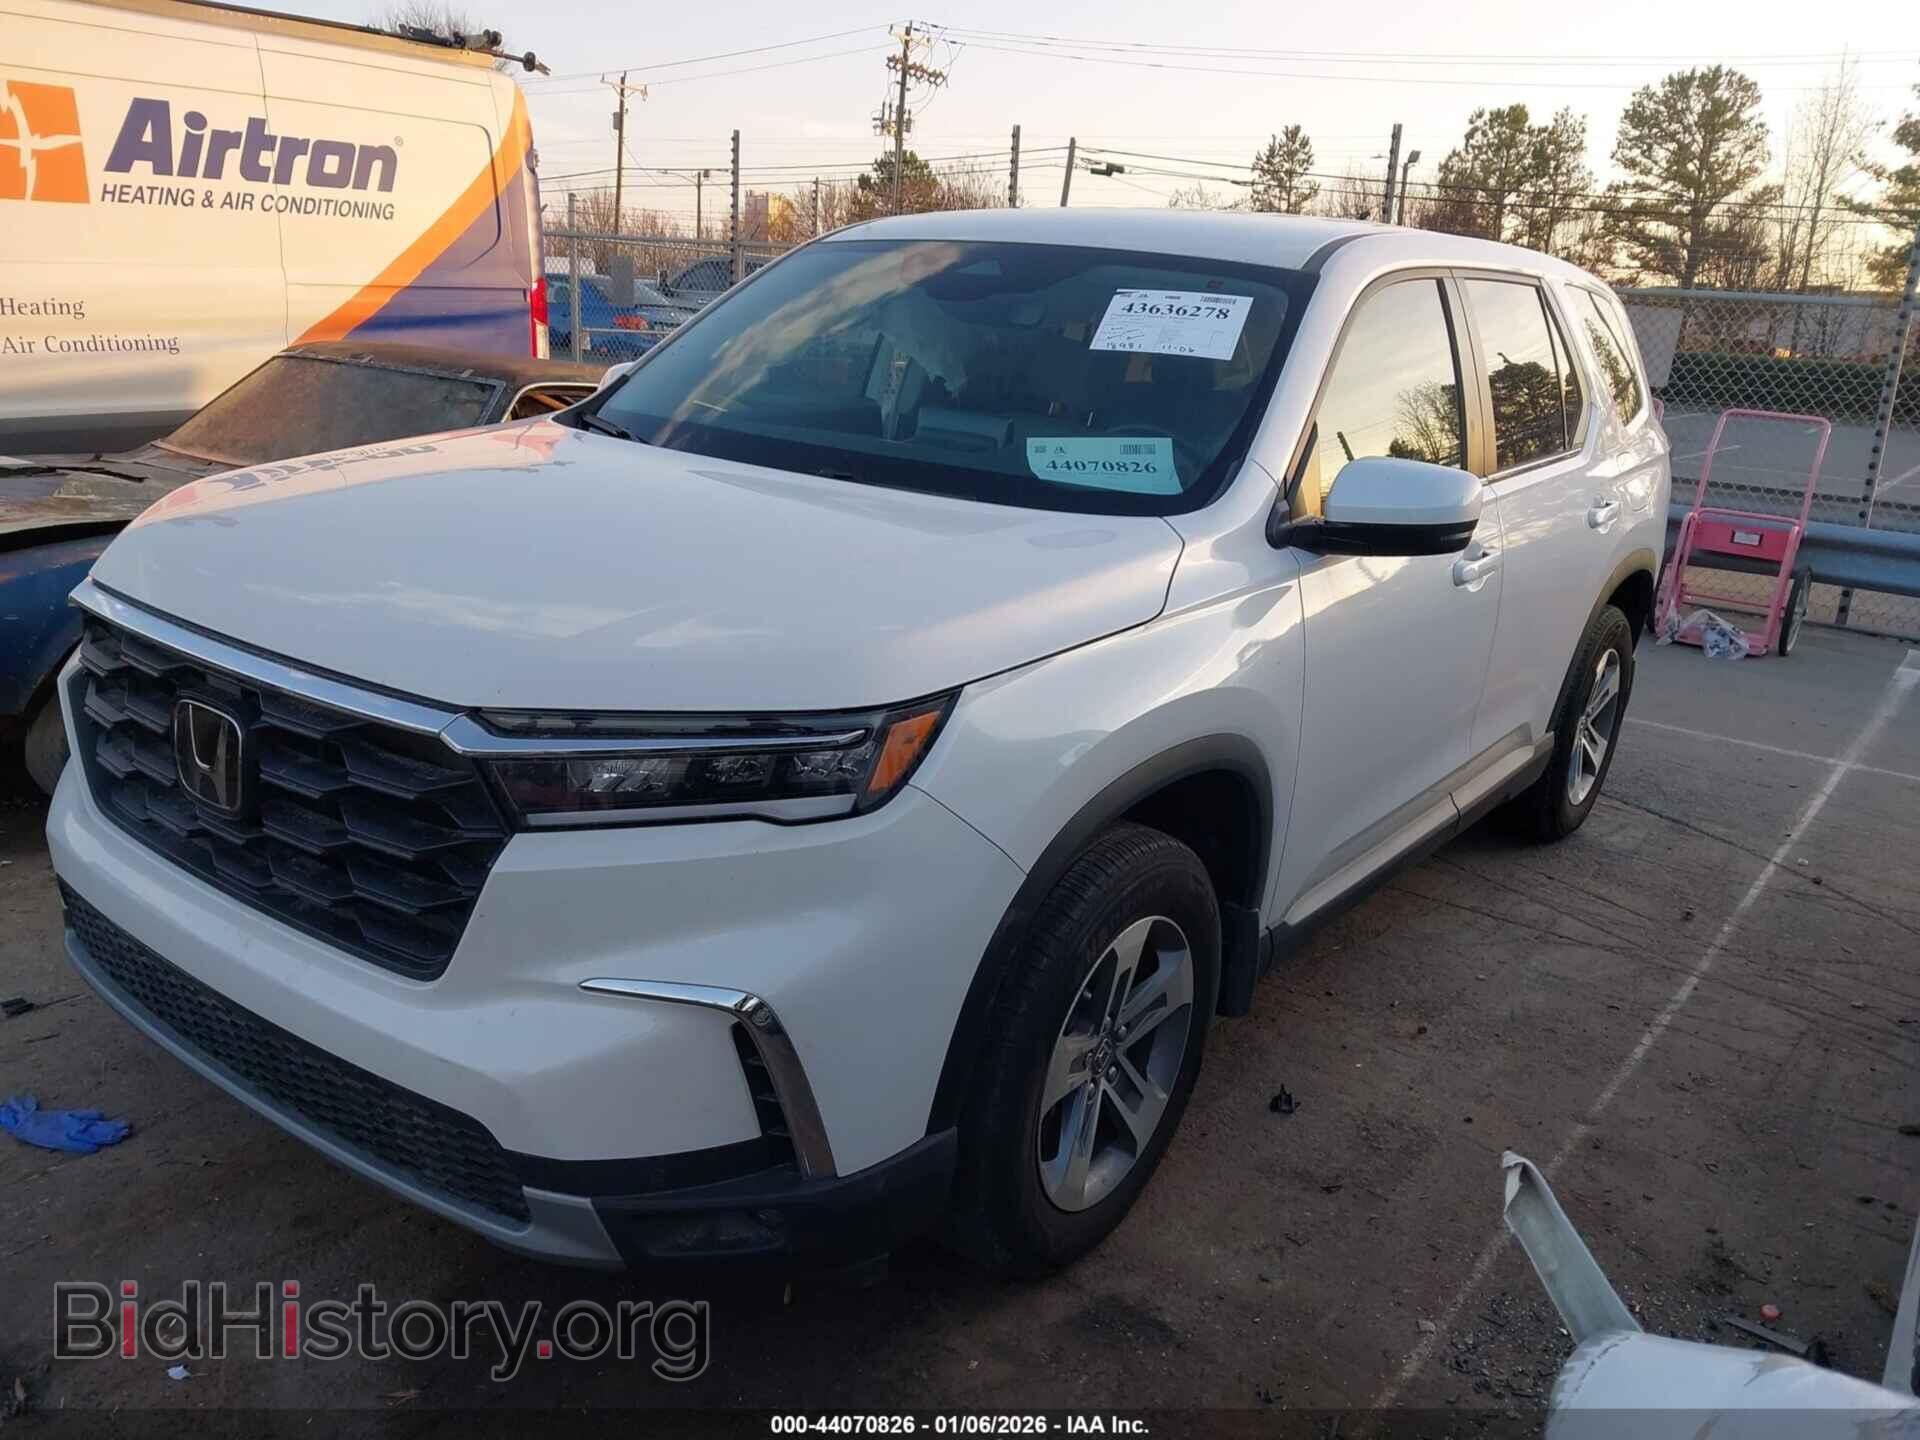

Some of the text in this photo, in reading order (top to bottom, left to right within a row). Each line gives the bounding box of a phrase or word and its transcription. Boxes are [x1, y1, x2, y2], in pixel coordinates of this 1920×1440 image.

[103, 97, 398, 192] Airtron
[101, 183, 395, 220] HEATING & AIR CONDITIONING
[0, 297, 86, 320] Heating
[1122, 302, 1230, 320] 43636278
[3, 334, 180, 355] Air Conditioning
[1046, 459, 1157, 474] 44070826
